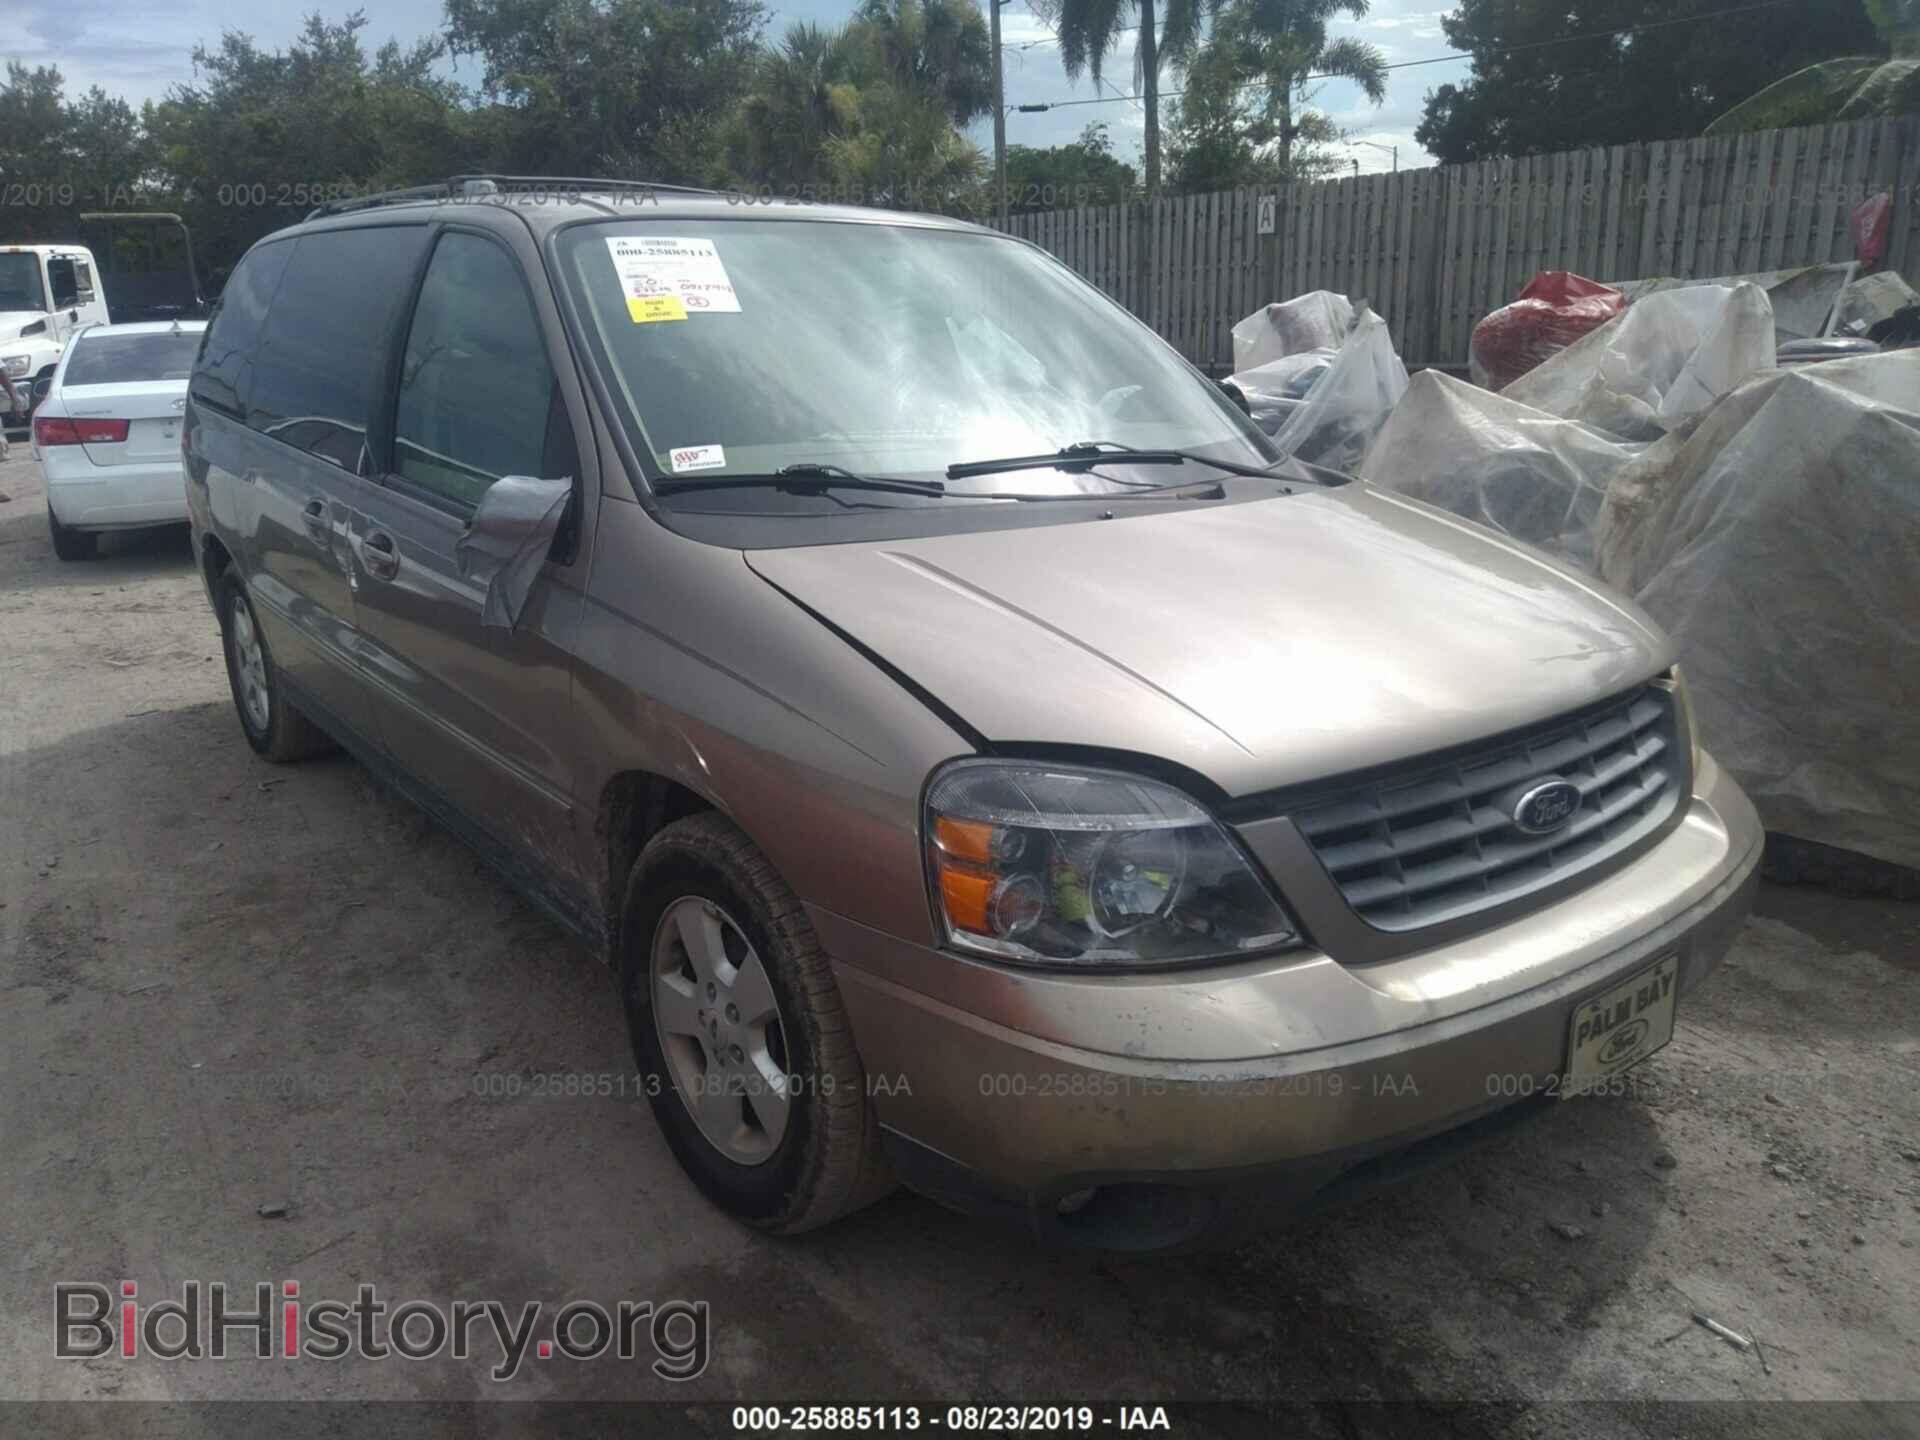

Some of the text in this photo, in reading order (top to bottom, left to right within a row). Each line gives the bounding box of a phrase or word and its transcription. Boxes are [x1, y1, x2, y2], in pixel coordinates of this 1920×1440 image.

[1260, 202, 1271, 228] A
[1577, 971, 1673, 1049] PALM BAY
